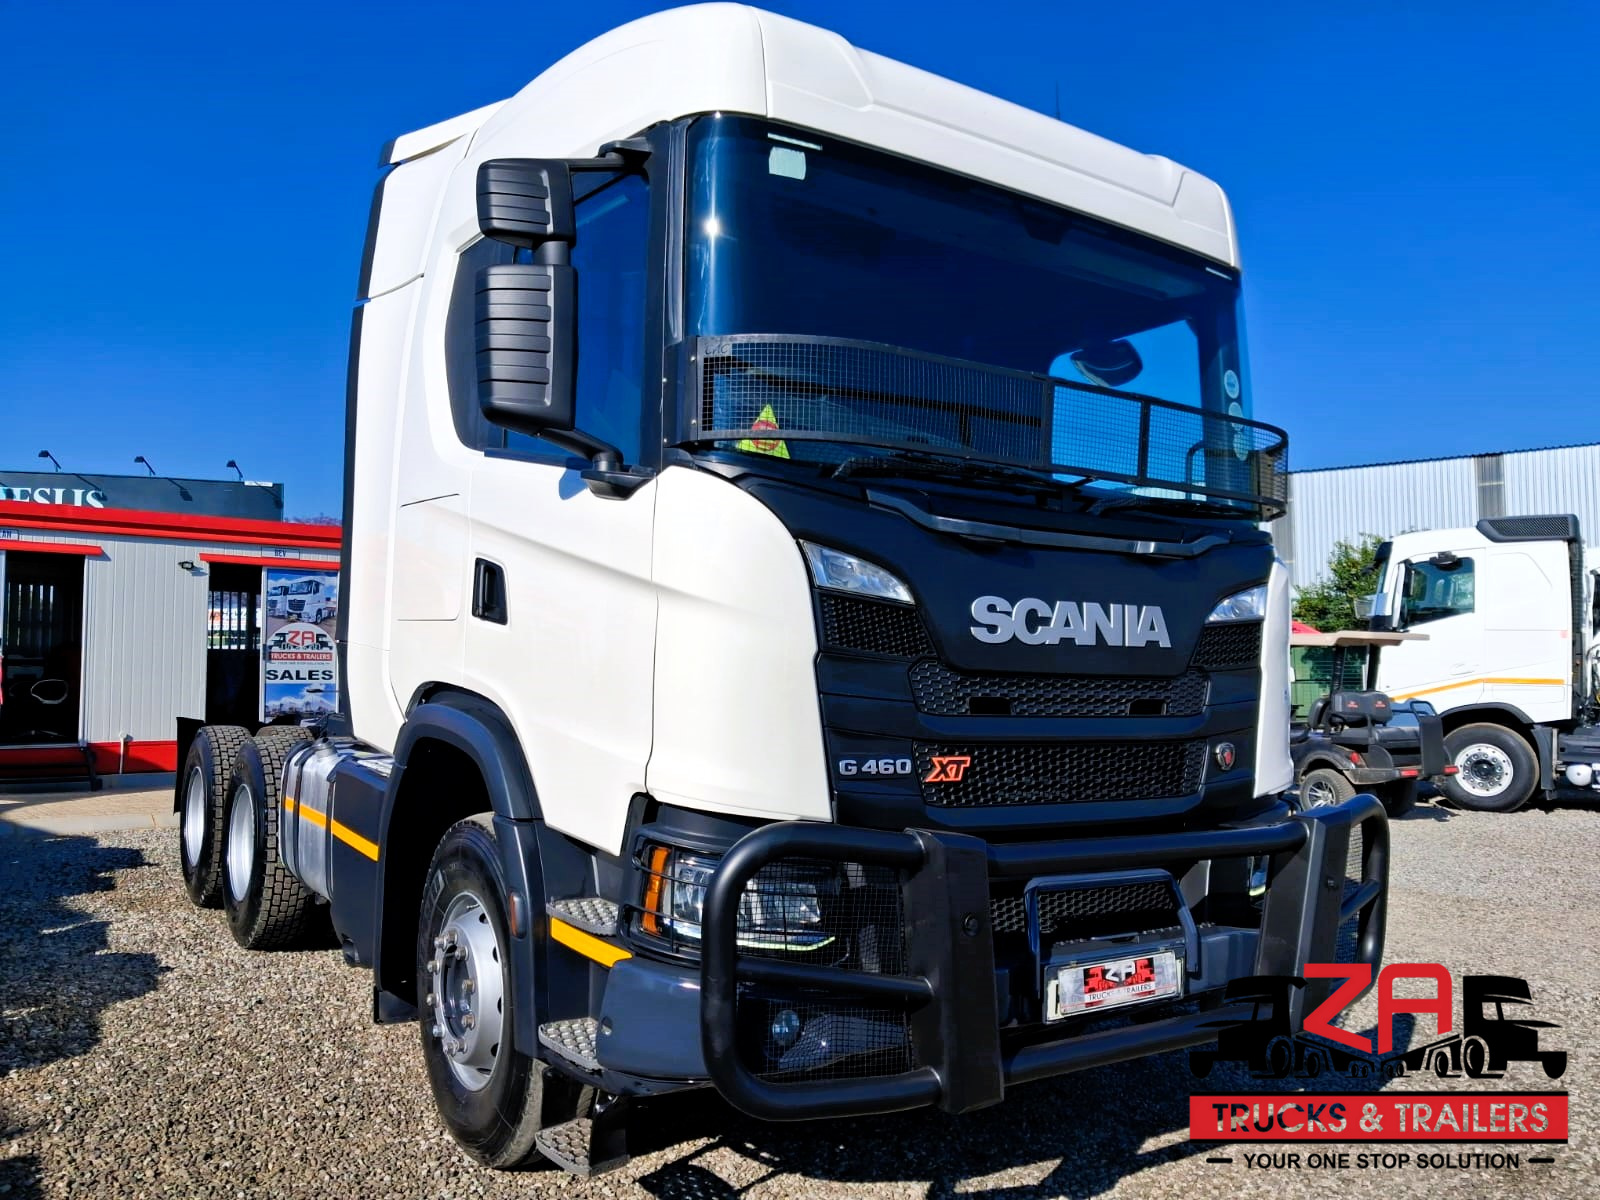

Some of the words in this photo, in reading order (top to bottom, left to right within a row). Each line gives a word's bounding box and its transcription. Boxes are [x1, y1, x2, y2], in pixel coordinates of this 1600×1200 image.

[970, 596, 1172, 648] SCANIA
[287, 630, 315, 646] ZA
[266, 669, 334, 681] SALES
[839, 759, 861, 776] G
[862, 758, 911, 775] 460
[925, 755, 971, 782] XT
[1124, 984, 1152, 994] RAILERS
